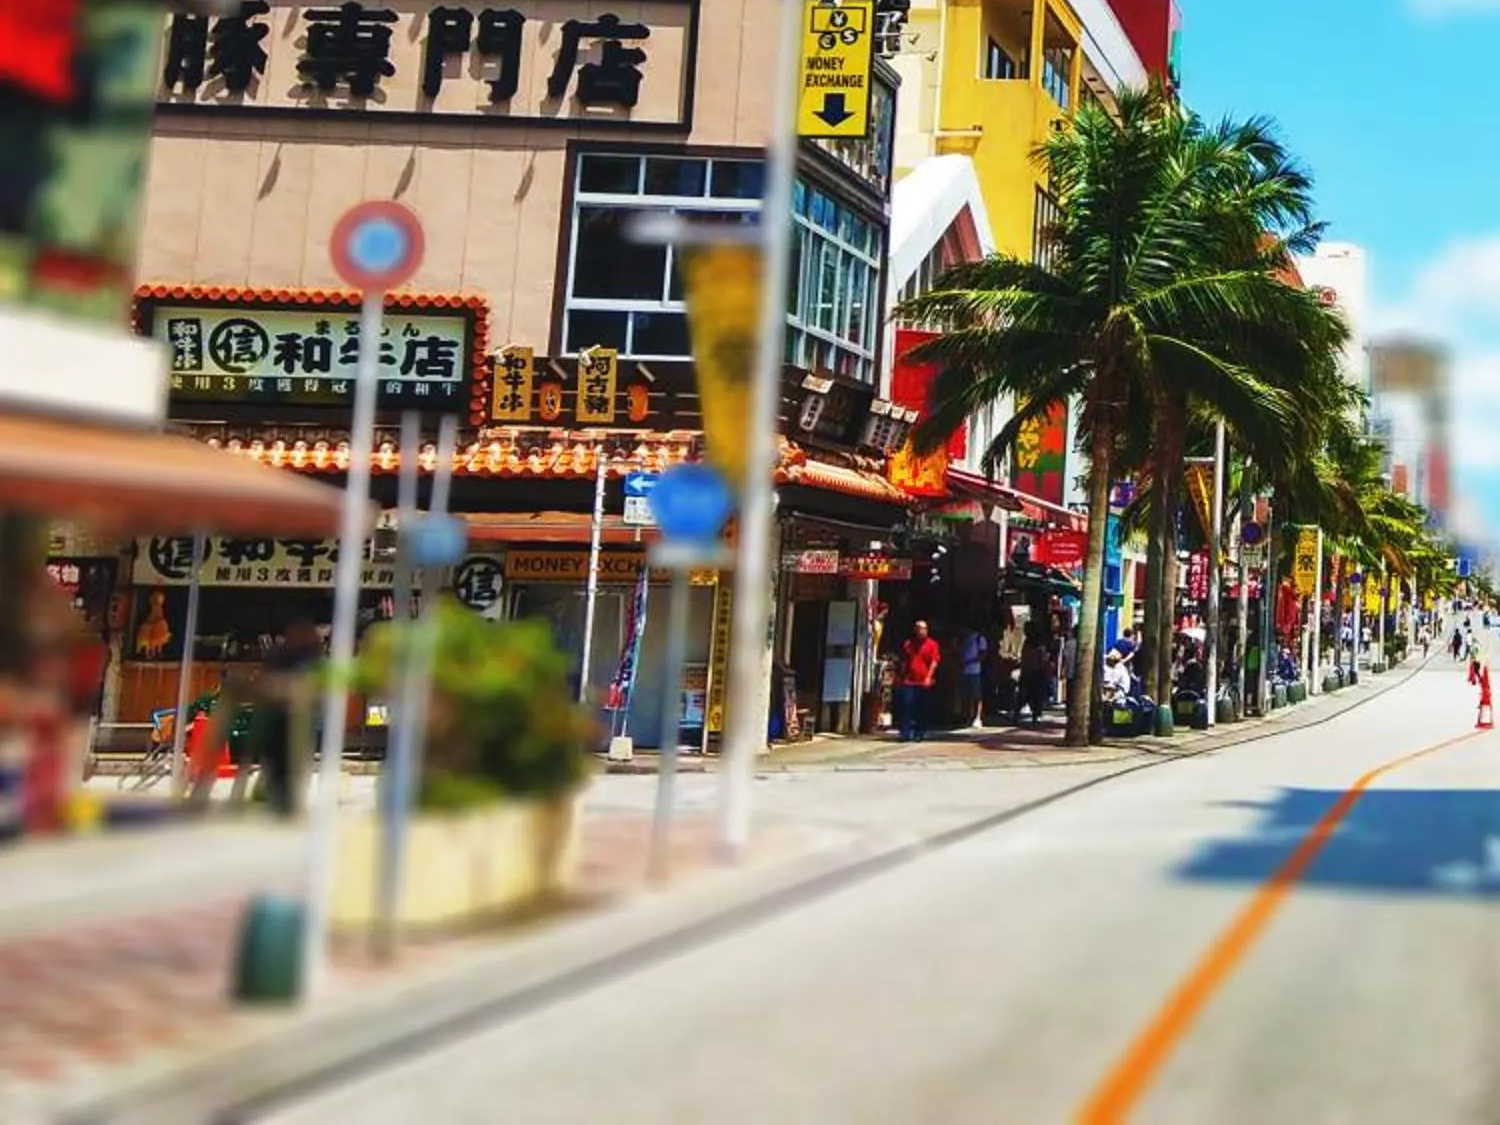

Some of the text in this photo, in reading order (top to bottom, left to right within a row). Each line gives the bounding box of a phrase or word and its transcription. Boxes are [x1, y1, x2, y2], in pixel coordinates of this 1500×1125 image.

[806, 57, 845, 70] MONEY
[805, 75, 864, 88] EXCHANGE
[314, 320, 421, 336] まるん
[513, 557, 584, 572] MONEY
